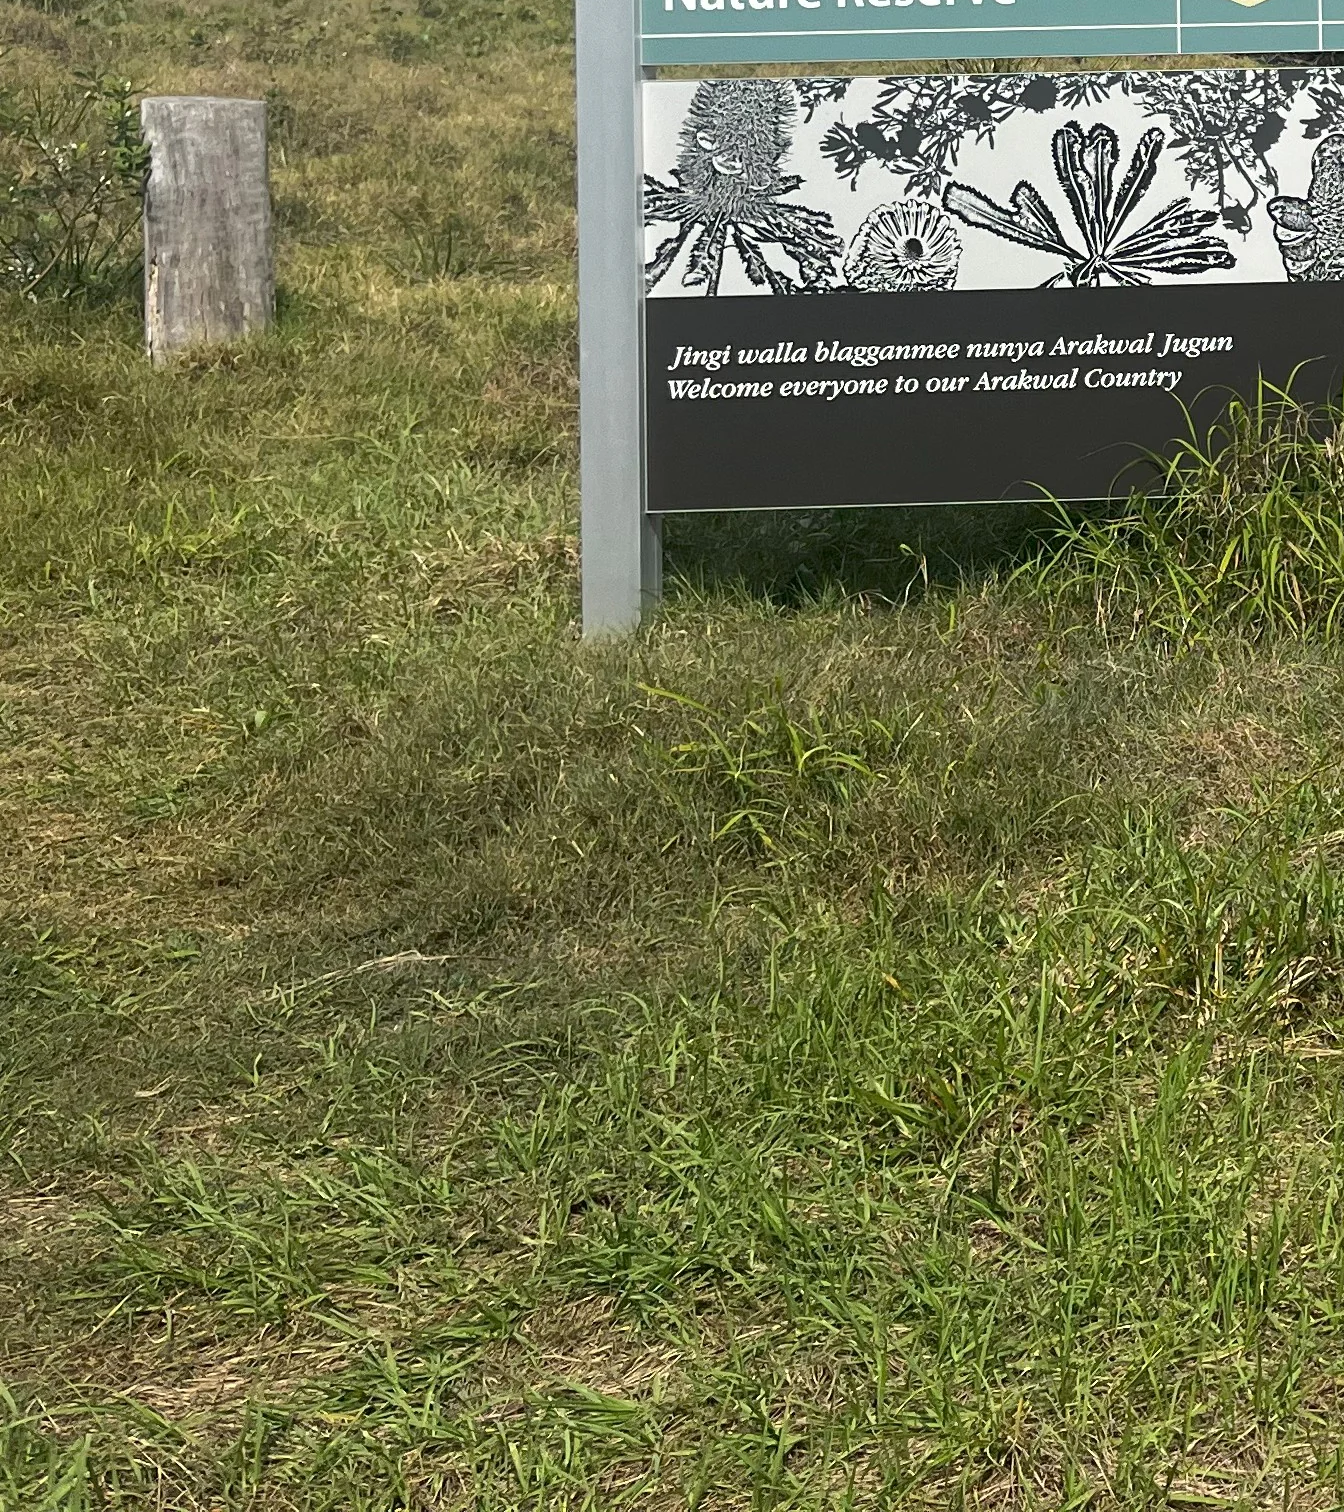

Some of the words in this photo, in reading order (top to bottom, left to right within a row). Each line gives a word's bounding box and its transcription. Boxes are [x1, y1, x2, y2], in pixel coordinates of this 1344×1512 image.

[667, 345, 732, 371] Jingi
[737, 342, 808, 365] walla
[814, 341, 960, 367] blagganmee
[966, 340, 1045, 362] nunya
[1049, 333, 1155, 356] Arakwal
[1157, 333, 1234, 358] Jugun
[667, 378, 773, 400] Welcome
[779, 376, 888, 401] everyone
[894, 375, 919, 394] to
[925, 377, 970, 392] our
[973, 368, 1080, 391] Arakwal
[1084, 368, 1183, 392] Country
